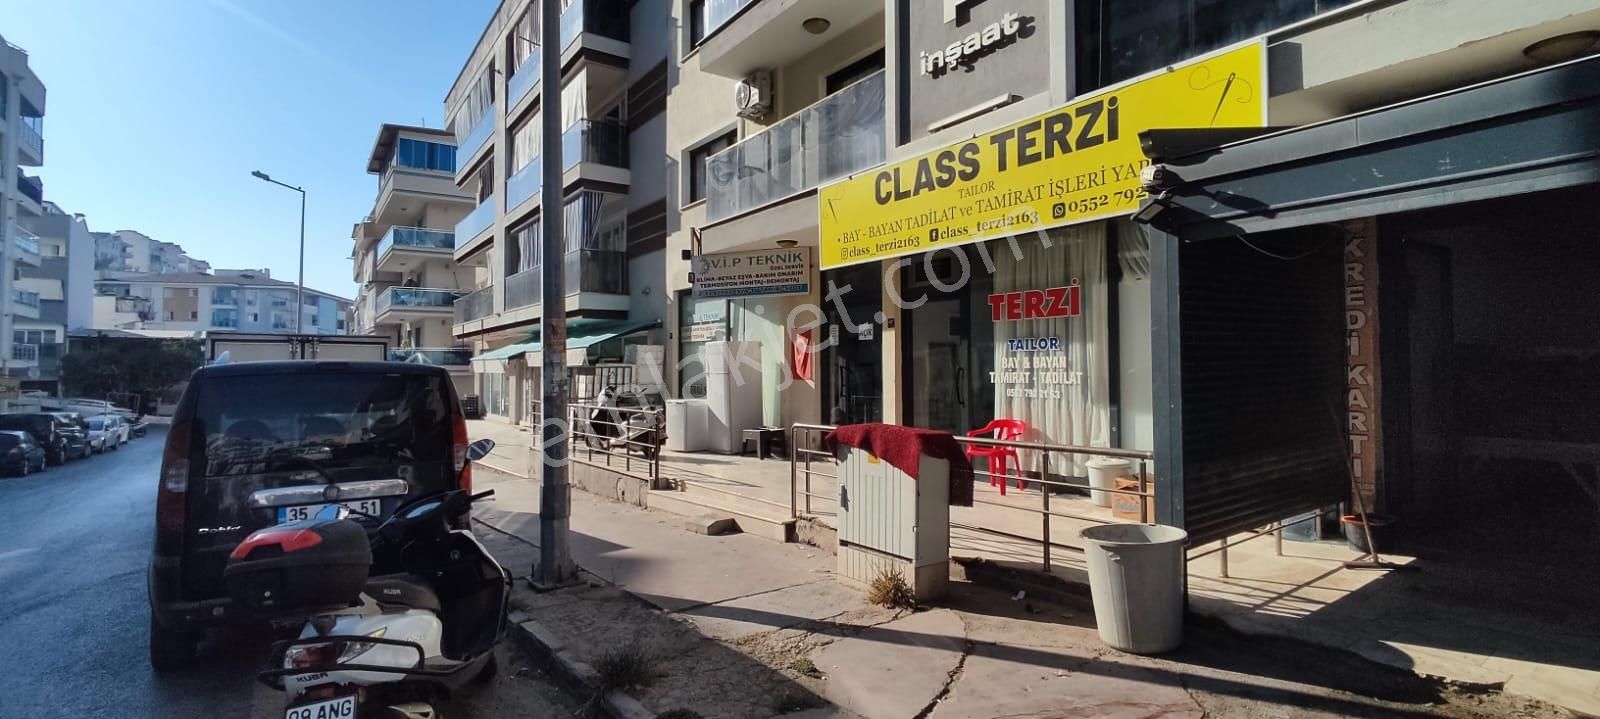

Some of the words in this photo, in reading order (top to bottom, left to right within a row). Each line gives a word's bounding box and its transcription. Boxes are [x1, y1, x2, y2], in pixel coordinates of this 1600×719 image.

[920, 12, 1018, 76] inşaat
[875, 142, 980, 206] CLASS
[843, 229, 862, 244] BAY
[868, 220, 903, 239] BAYAN
[903, 205, 957, 230] TADİLAT
[960, 207, 973, 217] ve
[975, 184, 1045, 214] TAMİRAT
[1048, 165, 1106, 200] İŞLERİ
[1068, 194, 1109, 213] 0552
[746, 251, 803, 266] TEKNİK
[988, 277, 1081, 322] TERZİ
[1008, 337, 1060, 352] TAILOR
[1001, 356, 1019, 369] BAY
[1033, 356, 1067, 369] BAYAN
[989, 369, 1031, 384] TAMİRAT
[1040, 369, 1083, 385] TADİLAT
[1348, 364, 1369, 478] KARTI
[289, 508, 308, 521] 35
[296, 672, 329, 682] KUBA
[317, 699, 352, 719] ANG
